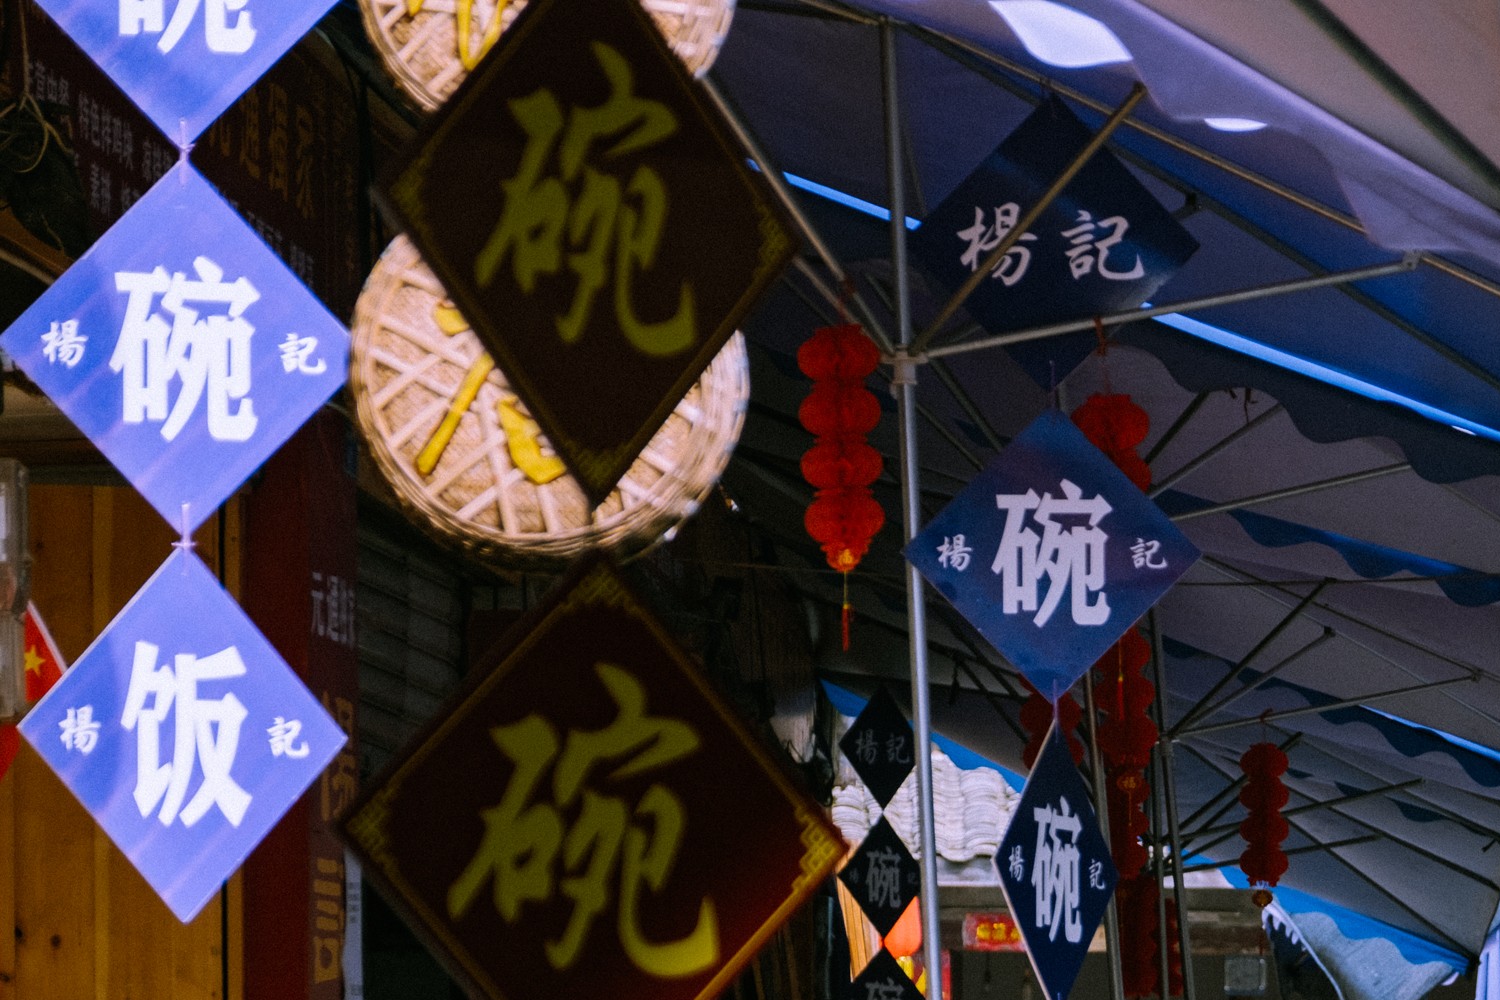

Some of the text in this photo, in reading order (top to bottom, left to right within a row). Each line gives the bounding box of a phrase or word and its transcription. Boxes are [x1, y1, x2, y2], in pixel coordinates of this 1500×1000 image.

[475, 40, 695, 357] 碗
[956, 202, 1146, 286] 楊記
[41, 256, 327, 441] 楊 碗 記
[937, 479, 1168, 627] 楊 碗 記
[59, 641, 310, 827] 楊 饭 記
[447, 662, 719, 977] 碗
[865, 846, 901, 908] 碗
[1031, 797, 1082, 942] 碗
